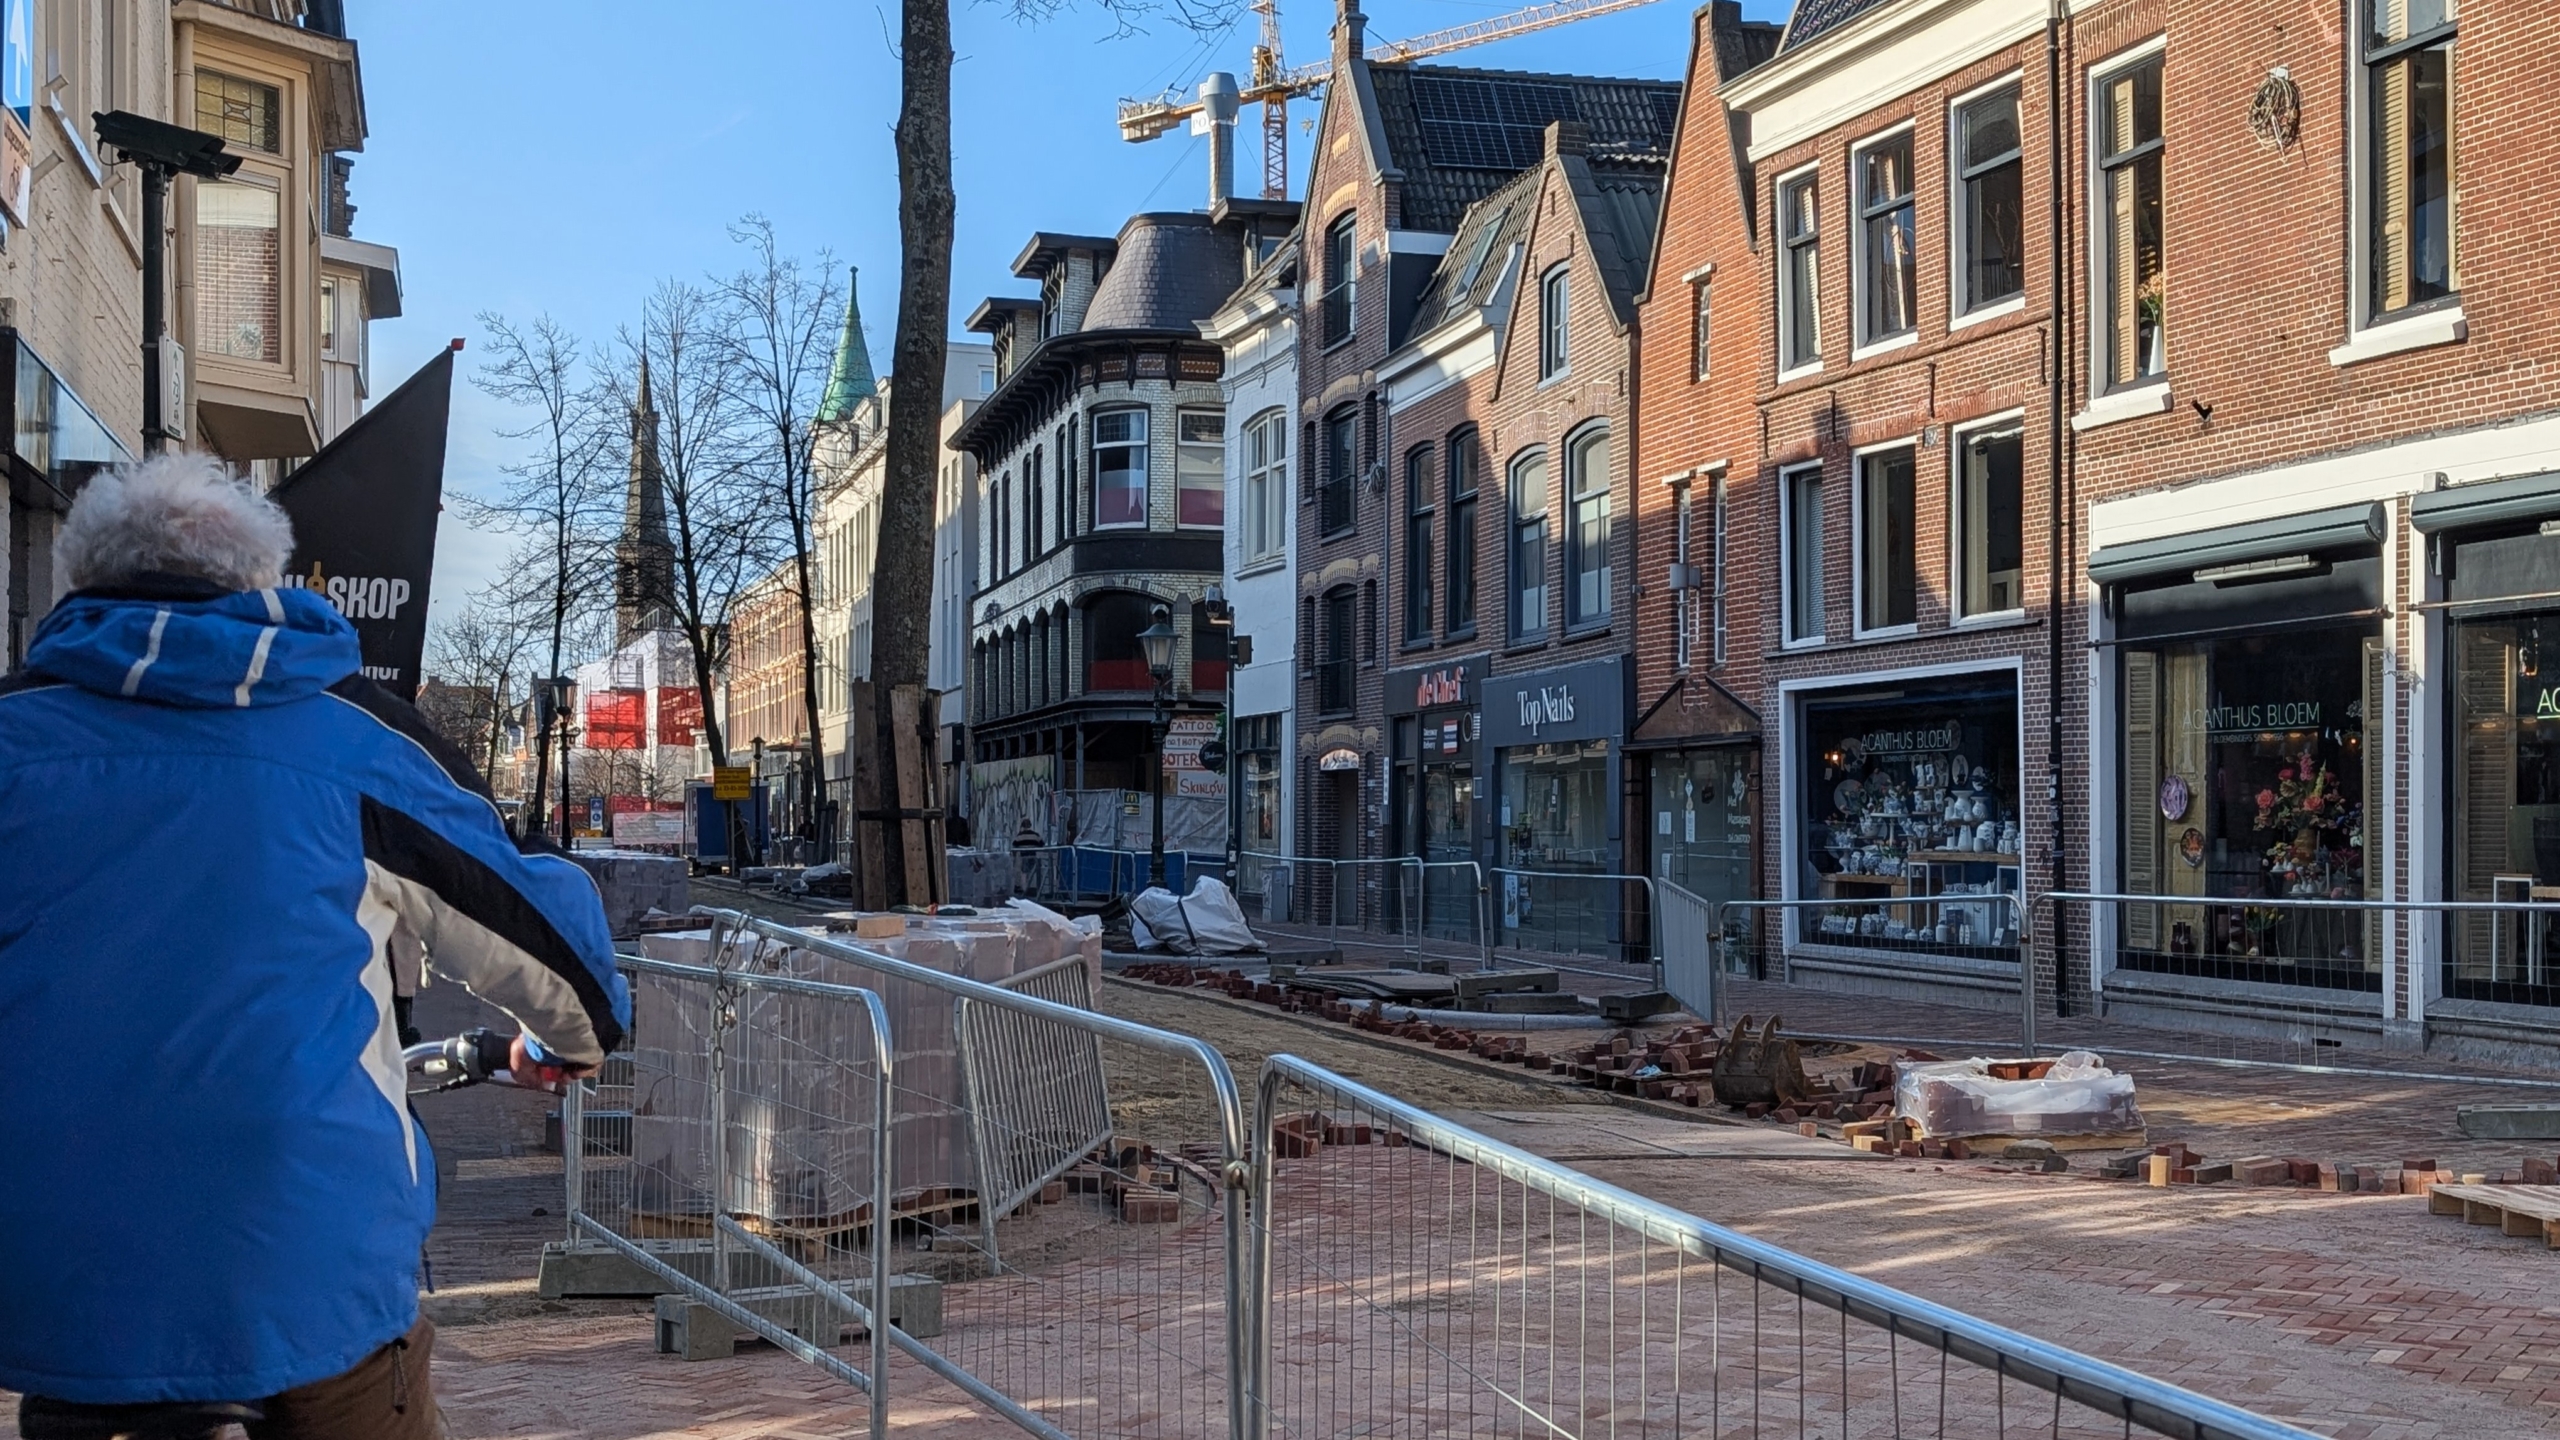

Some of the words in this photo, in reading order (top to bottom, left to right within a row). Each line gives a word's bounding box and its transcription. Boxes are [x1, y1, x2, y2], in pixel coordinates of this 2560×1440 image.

[1517, 690, 1541, 737] Top
[1541, 684, 1575, 724] Nails
[2182, 704, 2262, 730] ACANTHUS
[2267, 702, 2320, 726] BLOEM
[1860, 731, 1914, 751] ACANTHUS
[1916, 729, 1952, 749] BLOEM
